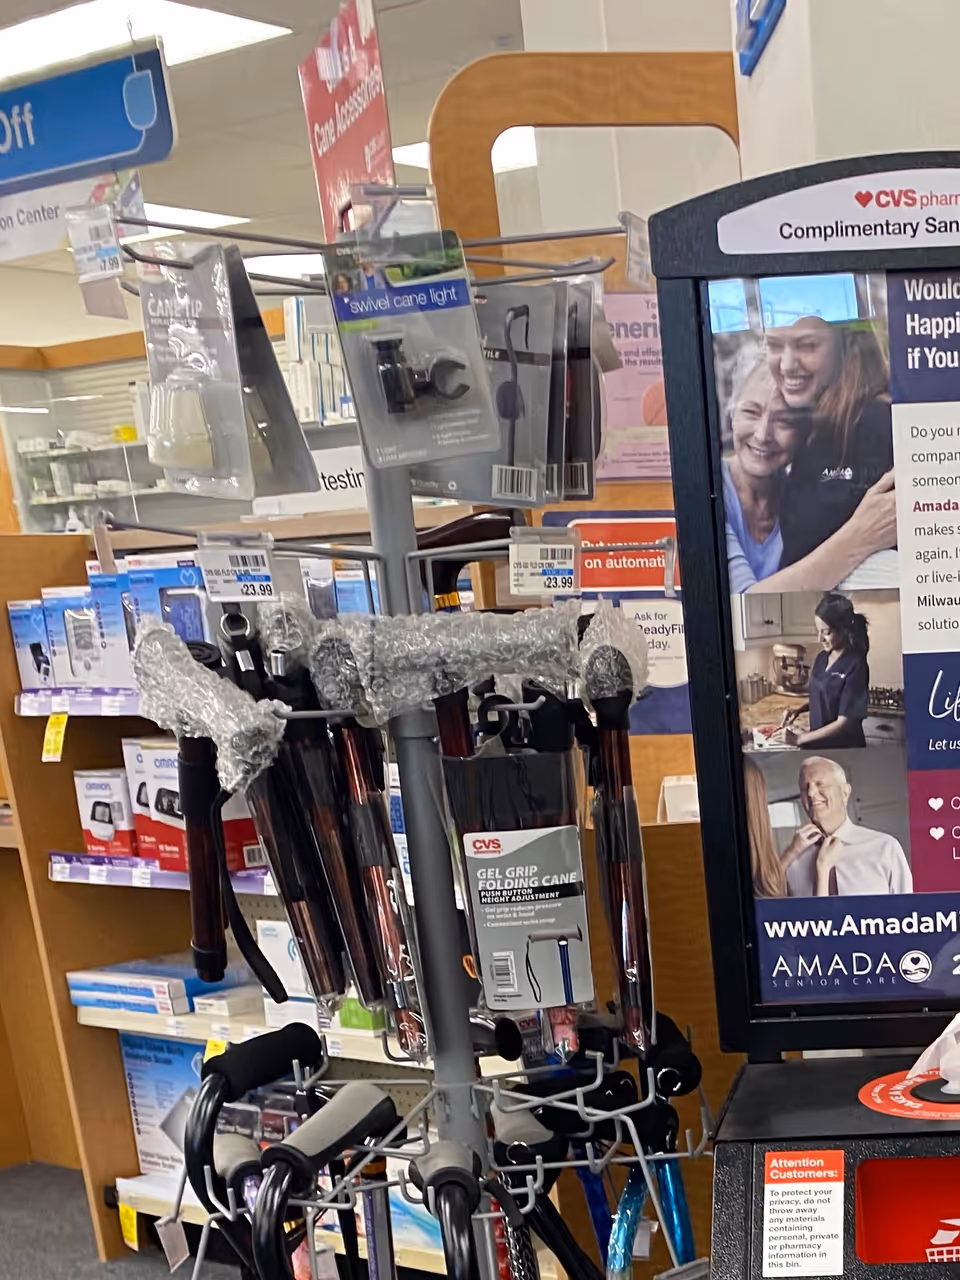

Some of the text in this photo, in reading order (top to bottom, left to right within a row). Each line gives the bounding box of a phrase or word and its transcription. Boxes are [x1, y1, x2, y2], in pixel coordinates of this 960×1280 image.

[314, 119, 336, 158] Cane
[875, 189, 917, 208] CVS
[16, 204, 60, 226] Center
[779, 219, 920, 242] Complimentary
[350, 286, 457, 314] swivel cane light
[148, 298, 182, 318] CANE
[607, 320, 661, 339] eneri
[907, 346, 920, 370] if
[923, 346, 959, 369] You
[910, 425, 928, 439] Do
[930, 427, 954, 441] you
[320, 467, 365, 491] testin
[912, 499, 960, 513] Amada
[585, 556, 665, 568] on automati
[634, 612, 667, 620] Ask for
[638, 624, 683, 636] eadyFil
[648, 640, 670, 650] day.
[473, 838, 501, 850] CVS
[477, 865, 538, 879] GEL GRIP
[478, 872, 578, 891] FOLDING CANE
[503, 888, 533, 896] BUTTON
[512, 892, 559, 902] ADJUSTMENT
[771, 951, 897, 978] AMADA
[772, 976, 897, 988] SENIOR CARE
[770, 1158, 824, 1168] Attention
[770, 1169, 837, 1179] Customers:
[782, 1189, 812, 1197] protect
[769, 1234, 807, 1242] personal,
